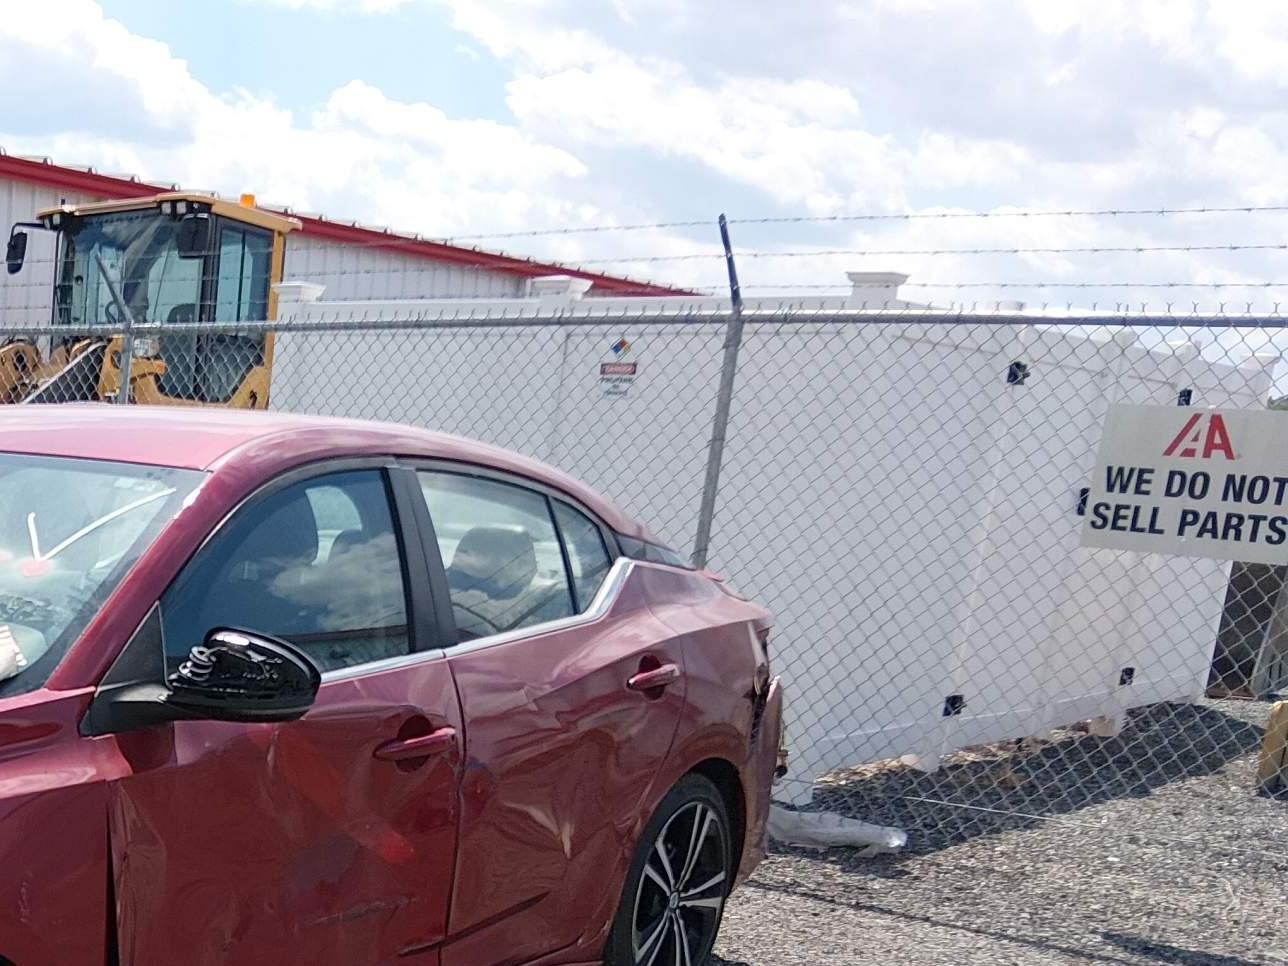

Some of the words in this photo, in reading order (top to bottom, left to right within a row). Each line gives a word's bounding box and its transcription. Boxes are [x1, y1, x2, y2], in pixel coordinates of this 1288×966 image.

[1105, 465, 1155, 496] WE
[1164, 469, 1210, 500] DO
[1221, 473, 1288, 506] NOT
[1089, 501, 1165, 535] SELL
[1177, 509, 1288, 545] PARTS
